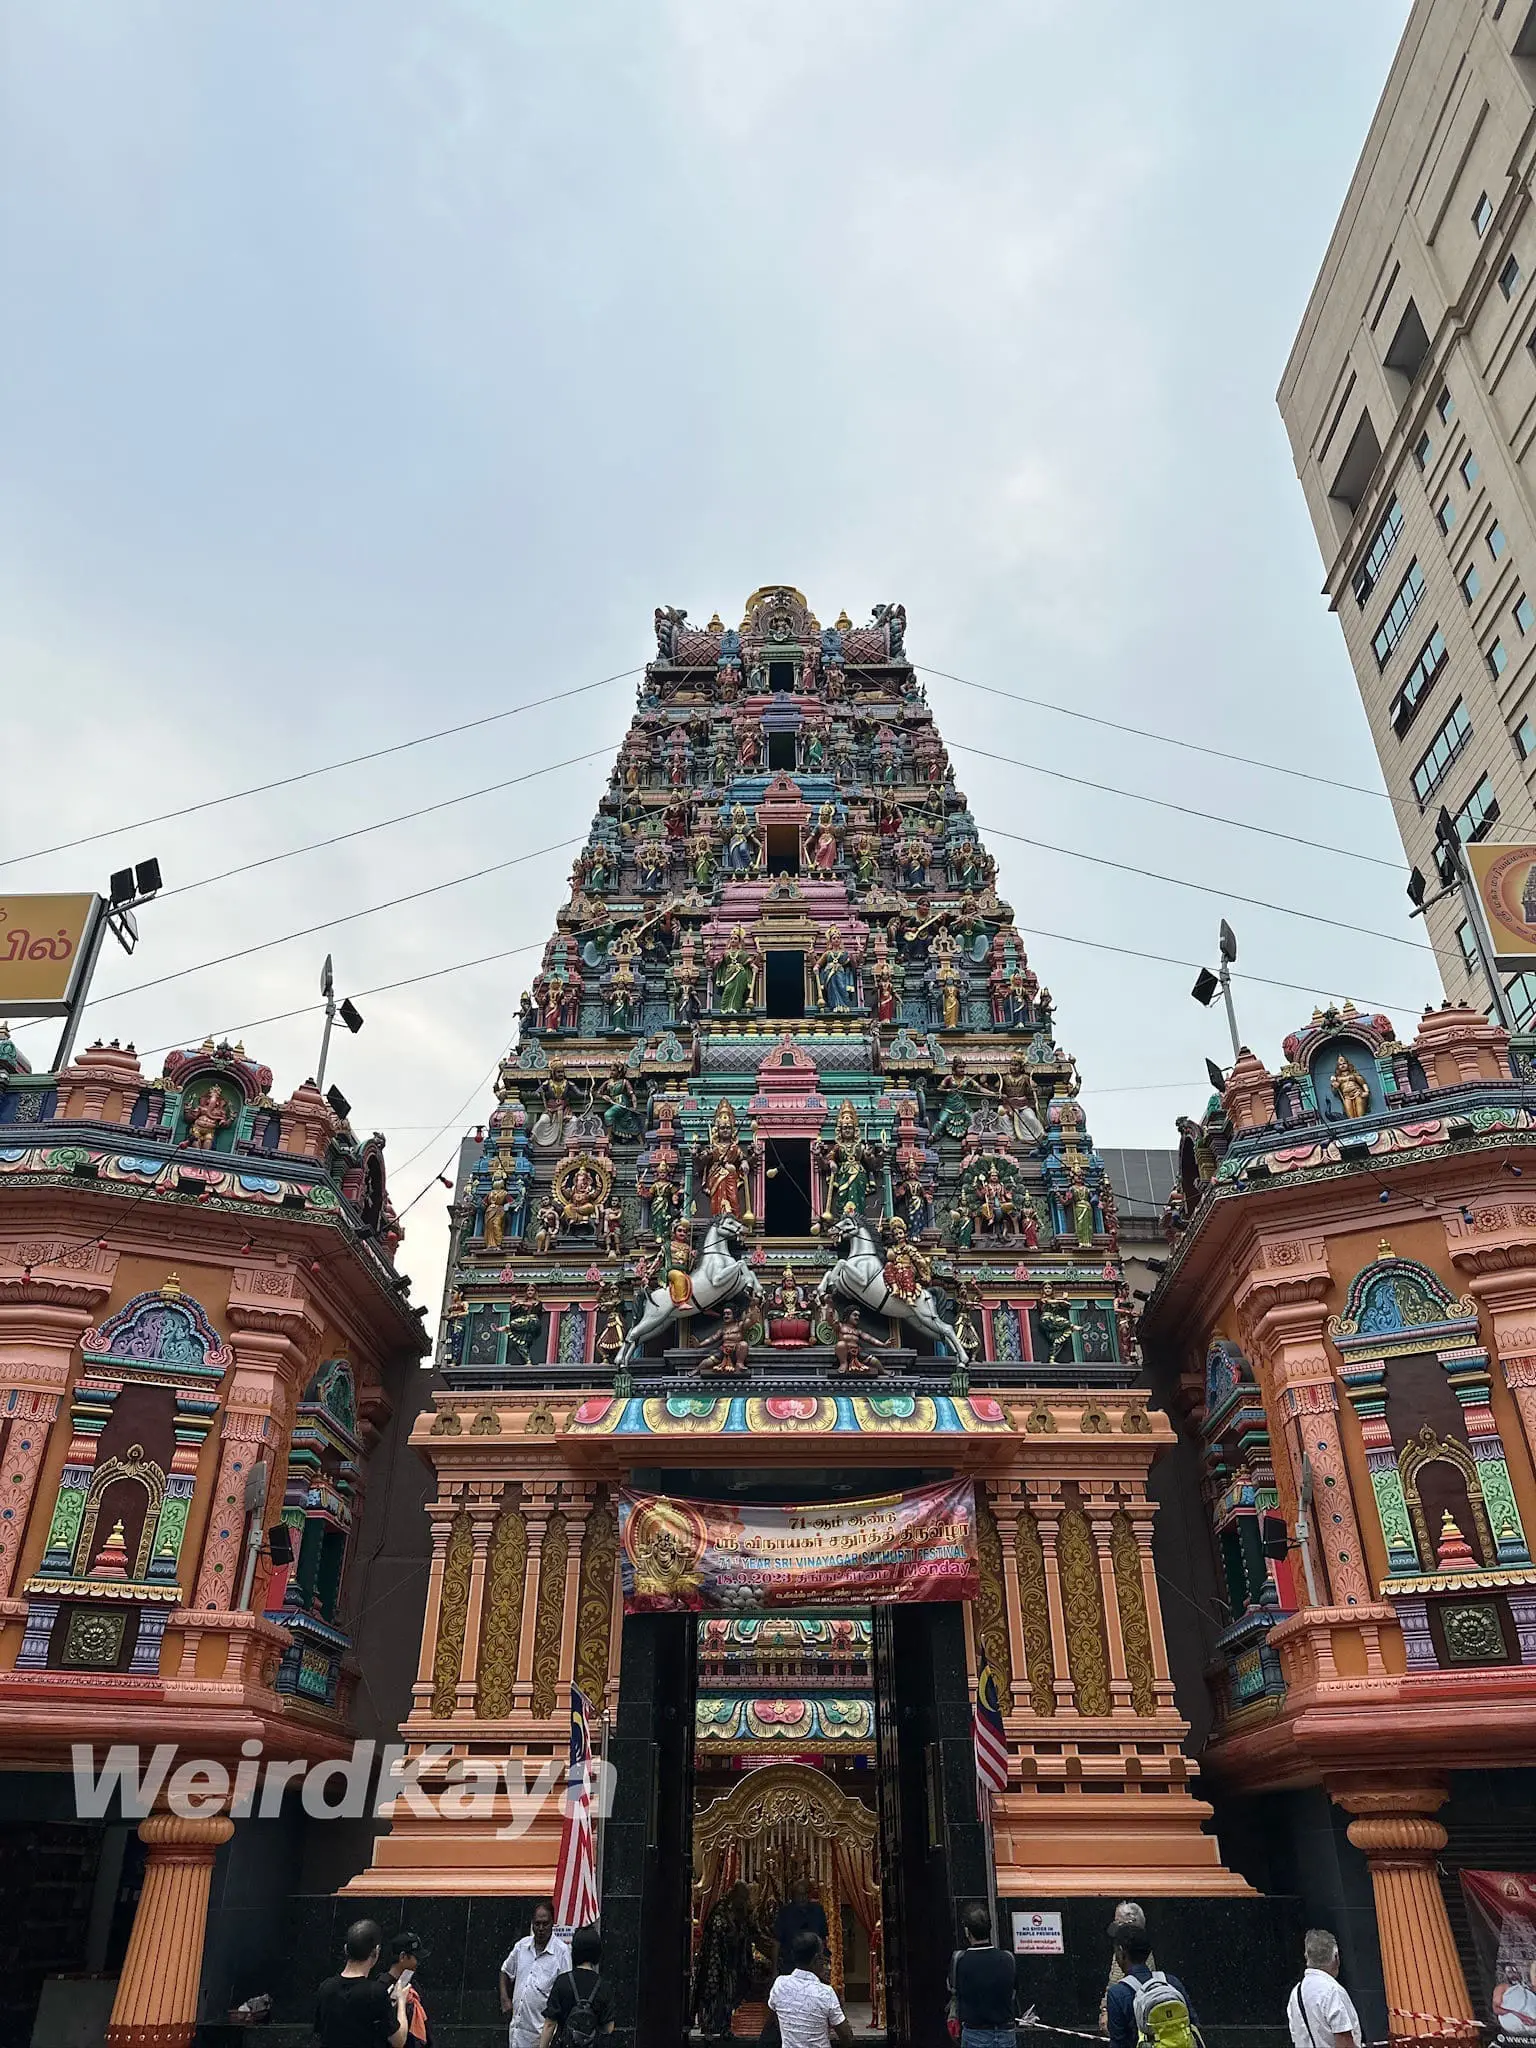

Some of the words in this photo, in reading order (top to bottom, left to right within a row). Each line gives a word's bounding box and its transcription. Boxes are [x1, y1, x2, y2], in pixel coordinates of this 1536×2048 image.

[745, 1532, 824, 1552] விநாயகர்
[900, 1520, 970, 1545] திருவிழா
[742, 1557, 771, 1570] YEAR
[774, 1557, 792, 1569] SRI
[795, 1553, 858, 1568] VINAYAGAR
[862, 1549, 914, 1566] SATHURTI
[917, 1544, 967, 1561] FESTIVAL
[716, 1572, 792, 1585] 18.9.2023
[903, 1559, 971, 1580] Monday
